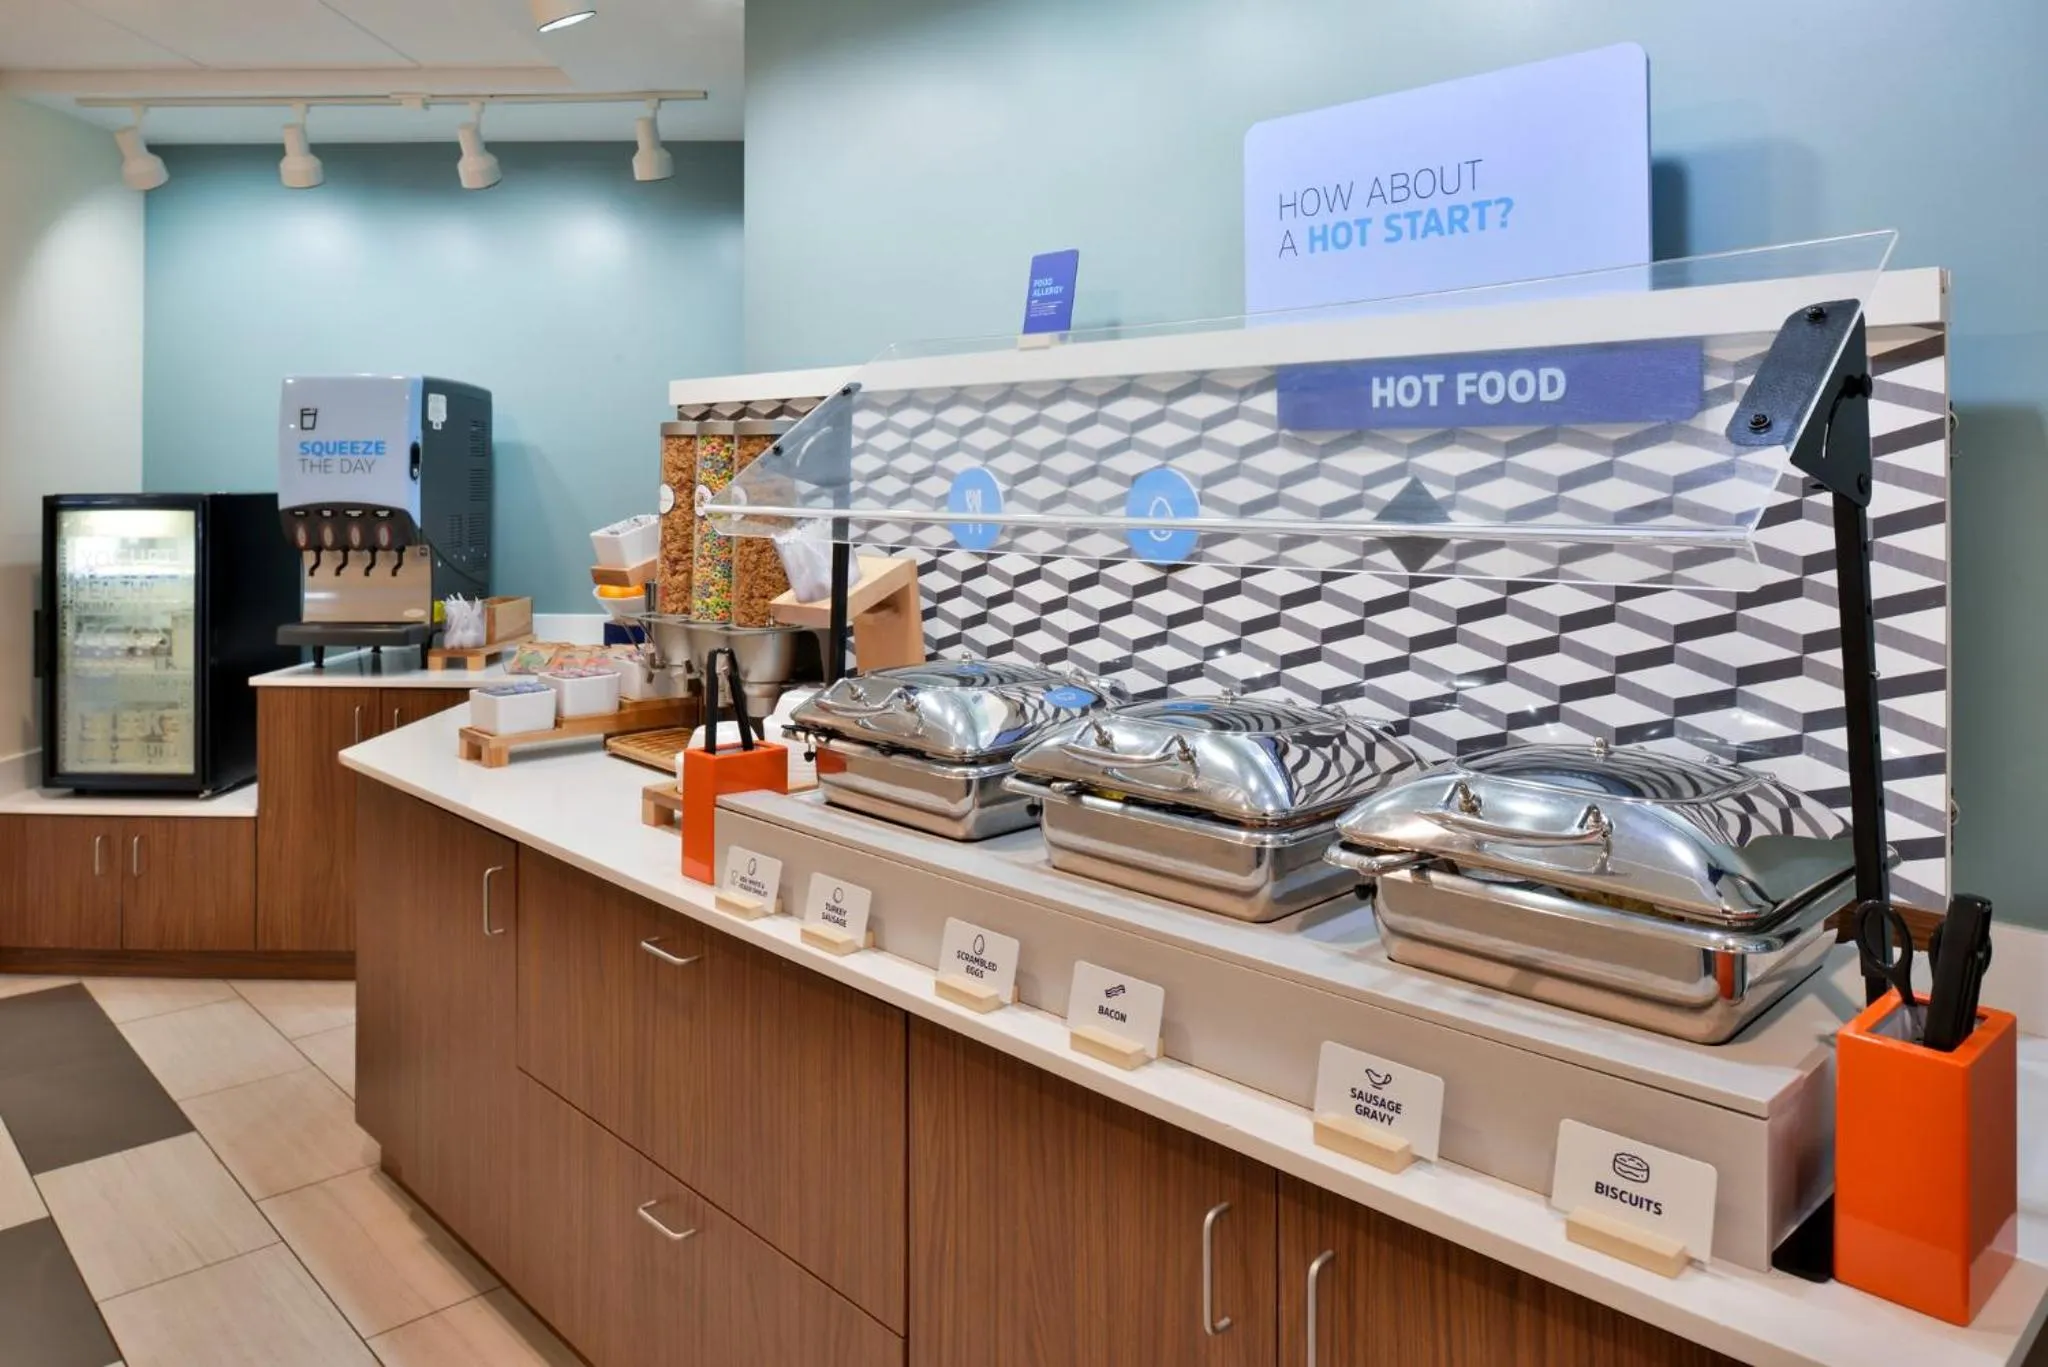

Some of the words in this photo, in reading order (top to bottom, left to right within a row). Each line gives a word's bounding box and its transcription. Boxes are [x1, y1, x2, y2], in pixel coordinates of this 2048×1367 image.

[1279, 181, 1354, 220] HOW
[1366, 159, 1483, 208] ABOUT
[1279, 230, 1298, 258] A
[1308, 217, 1373, 254] HOT
[1383, 197, 1514, 243] START?
[1031, 286, 1064, 297] ALLERGY
[1371, 374, 1445, 408] HOT
[1457, 368, 1567, 405] FOOD
[298, 440, 386, 456] SQUEEZE
[298, 458, 333, 474] THE
[339, 458, 376, 474] DAY
[825, 901, 847, 917] TURKEY
[821, 911, 847, 928] SAUSAGE
[956, 950, 998, 972] SCRAMBLED
[965, 965, 984, 979] EGGS
[1097, 1005, 1127, 1023] BACON
[1350, 1087, 1402, 1115] SAUSAGE
[1355, 1104, 1394, 1126] GRAVY
[1594, 1181, 1663, 1216] BISCUITS
